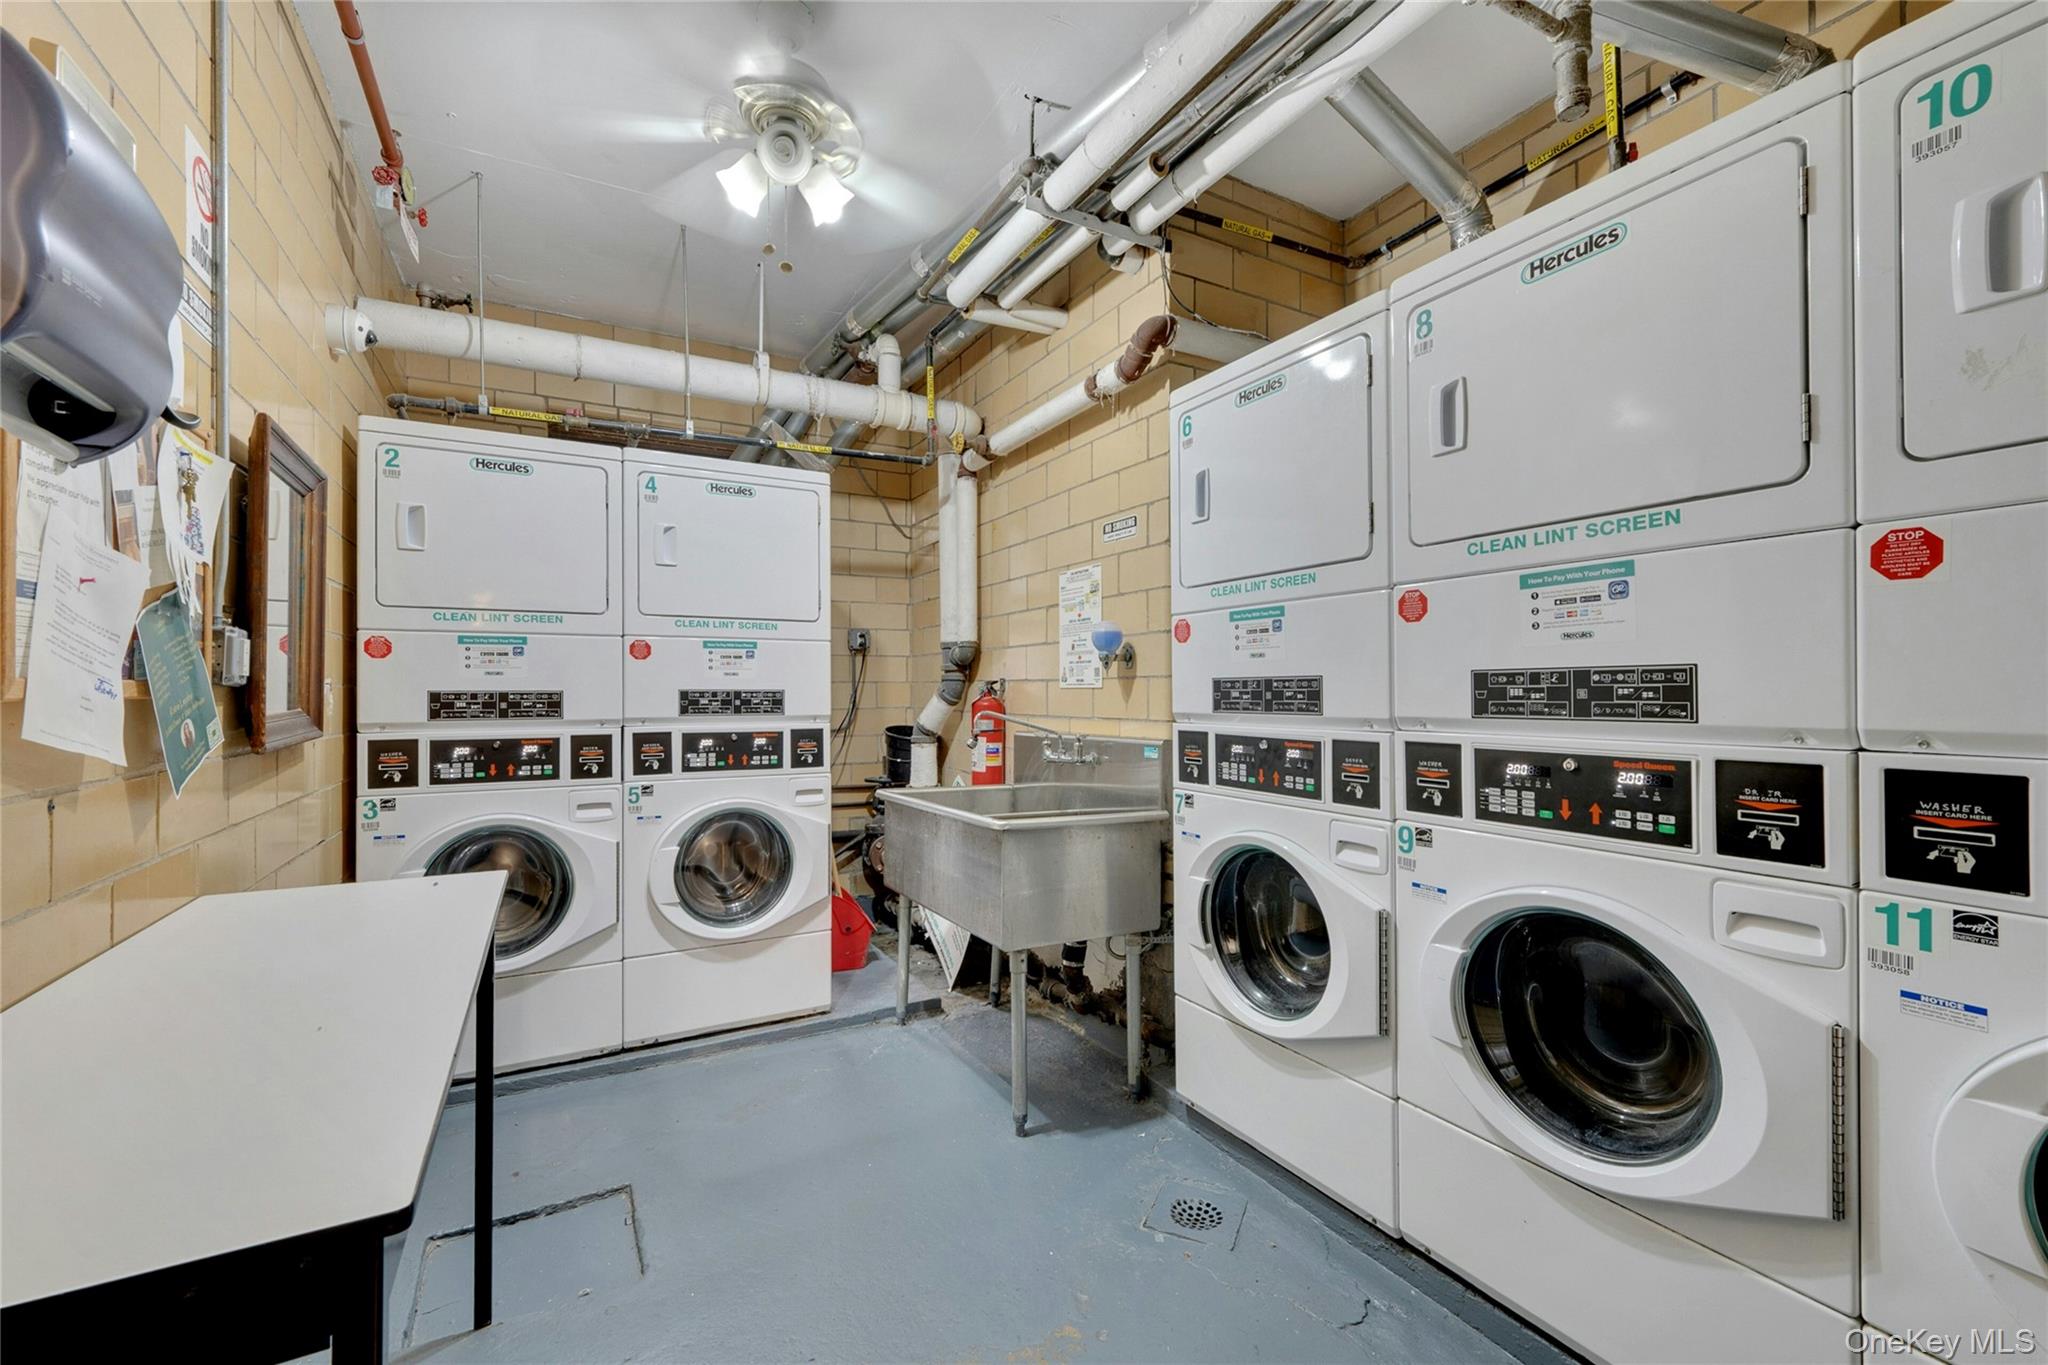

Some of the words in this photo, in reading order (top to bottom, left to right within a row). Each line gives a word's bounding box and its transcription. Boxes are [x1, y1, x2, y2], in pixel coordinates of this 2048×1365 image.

[1917, 64, 1992, 130] 10
[1529, 138, 1572, 168] NATURAL
[1574, 123, 1596, 141] GAS
[1915, 141, 1957, 163] 393057
[1224, 220, 1250, 234] NATURAL
[1253, 229, 1265, 238] GAS
[1530, 227, 1619, 279] Hercules
[1416, 309, 1433, 340] 8
[1239, 378, 1283, 404] Hercules
[502, 409, 542, 419] NATURAL
[1183, 415, 1192, 437] 6
[384, 448, 400, 468] 2
[476, 458, 529, 474] Hercules
[645, 476, 657, 493] 4
[710, 483, 753, 496] Hercules
[1467, 534, 1527, 556] CLEAN
[1534, 526, 1578, 546] LINT
[1585, 508, 1681, 538] SCREEN
[1888, 530, 1925, 541] STOP
[1566, 571, 1583, 579] With
[1602, 567, 1626, 575] Phone
[1210, 584, 1241, 598] CLEAN
[1245, 580, 1266, 592] LINT
[1270, 572, 1316, 589] SCREEN
[433, 612, 477, 622] CLEAN
[481, 613, 509, 622] LINT
[513, 614, 563, 624] SCREEN
[675, 619, 710, 628] CLEAN
[713, 620, 736, 629] LINT
[738, 621, 778, 631] SCREEN
[1613, 761, 1643, 769] Speed
[1644, 762, 1676, 771] Queen
[628, 787, 640, 804] 5
[1175, 794, 1184, 814] 7
[363, 800, 378, 820] 3
[1920, 801, 1985, 815] WASHER
[1398, 826, 1414, 853] 9
[1875, 902, 1932, 952] 11
[1953, 933, 1979, 942] ENERGY
[1981, 938, 1999, 946] STAR
[1871, 962, 1910, 976] 393058
[1920, 994, 1965, 1011] NOTICE
